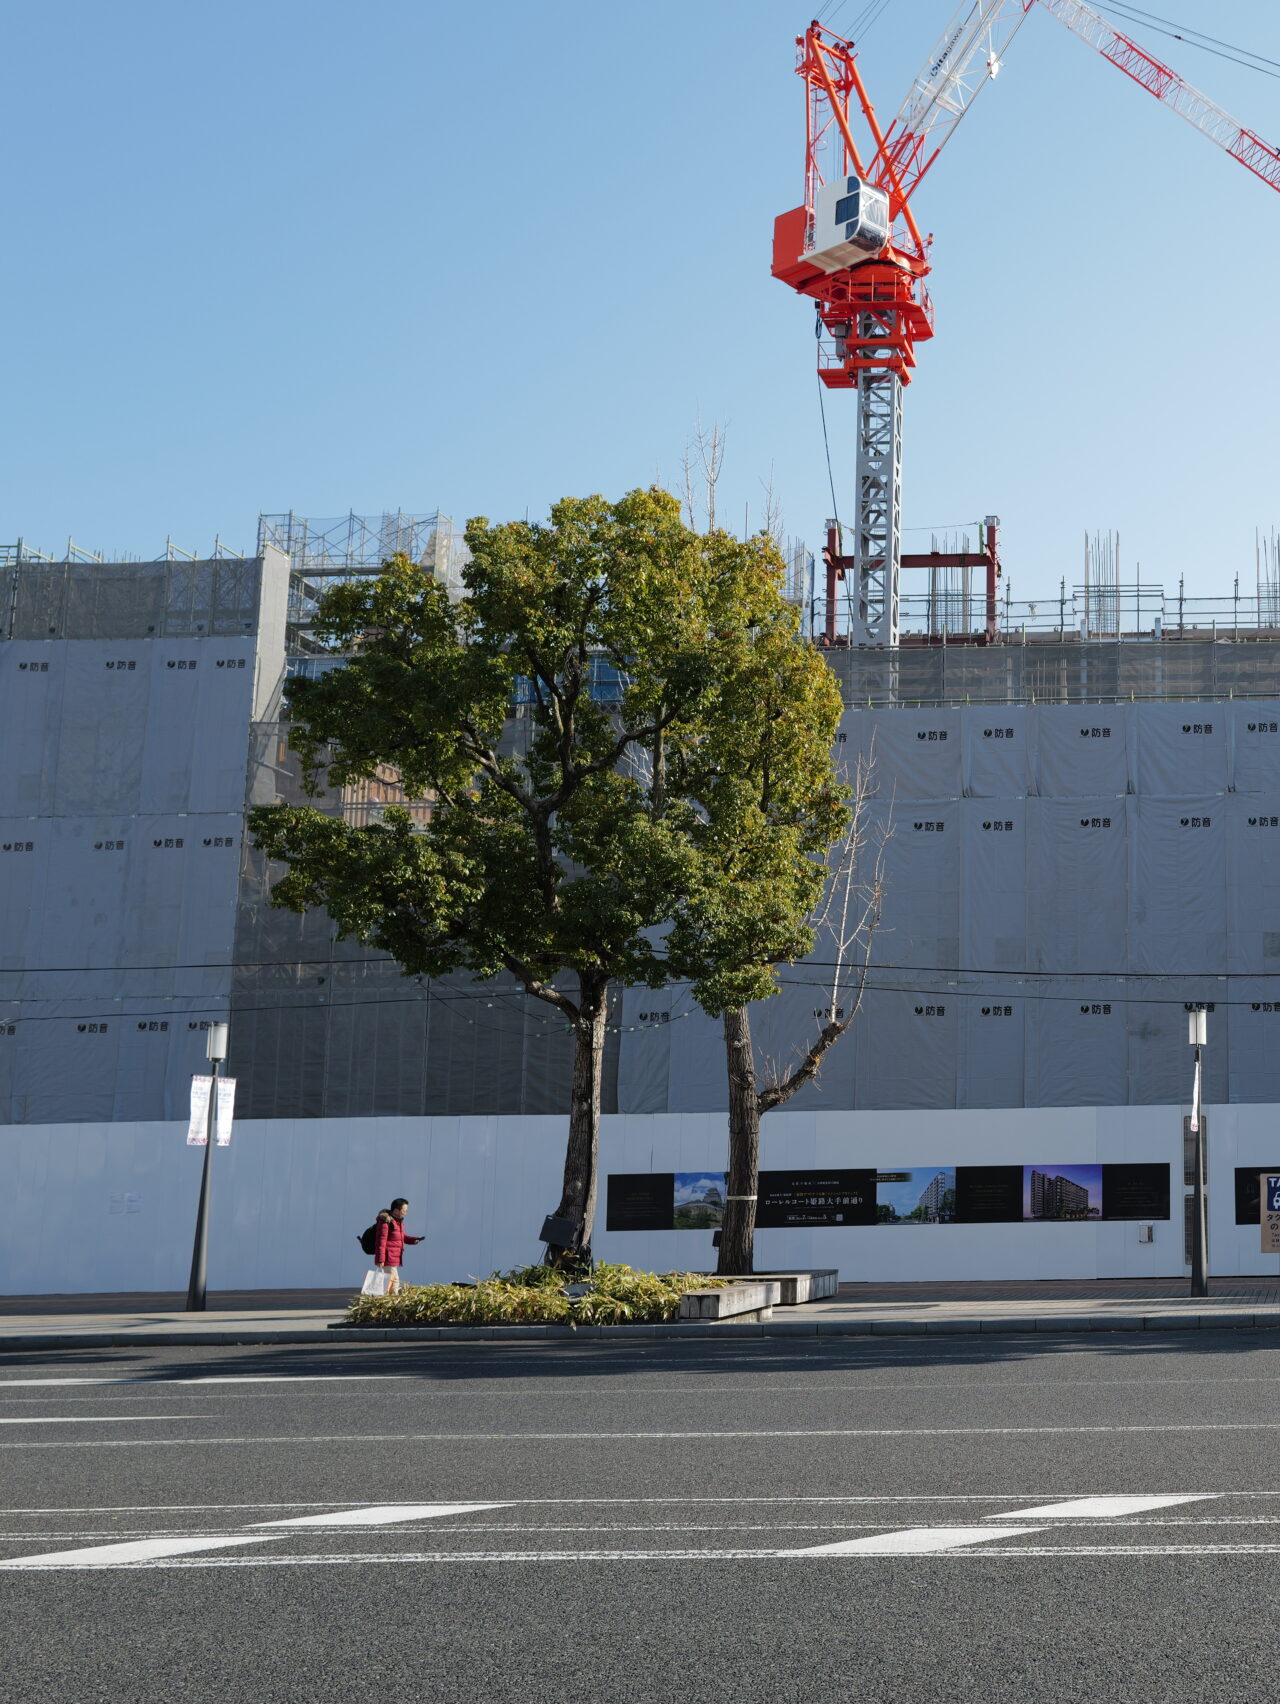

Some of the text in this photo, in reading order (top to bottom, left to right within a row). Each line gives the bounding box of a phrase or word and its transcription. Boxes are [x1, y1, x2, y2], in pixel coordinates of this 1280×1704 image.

[29, 662, 49, 672] 防音
[117, 661, 137, 671] 防音
[177, 660, 197, 670] 防音
[226, 659, 246, 669] 防音
[994, 728, 1014, 738] 防音
[1091, 728, 1111, 738] 防音
[1193, 724, 1213, 734] 防音
[1258, 723, 1278, 733] 防音
[928, 731, 948, 741] 防音
[925, 822, 945, 832] 防音
[993, 821, 1013, 831] 防音
[1091, 818, 1111, 828] 防音
[1191, 817, 1211, 827] 防音
[1259, 817, 1279, 827] 防音
[14, 842, 34, 852] 防音
[105, 840, 125, 850] 防音
[164, 838, 184, 848] 防音
[214, 837, 234, 847] 防音
[925, 1006, 945, 1016] 防音
[993, 1006, 1013, 1016] 防音
[1092, 1005, 1112, 1015] 防音
[650, 1012, 670, 1022] 防音
[88, 1023, 108, 1033] 防音
[149, 1021, 169, 1031] 防音
